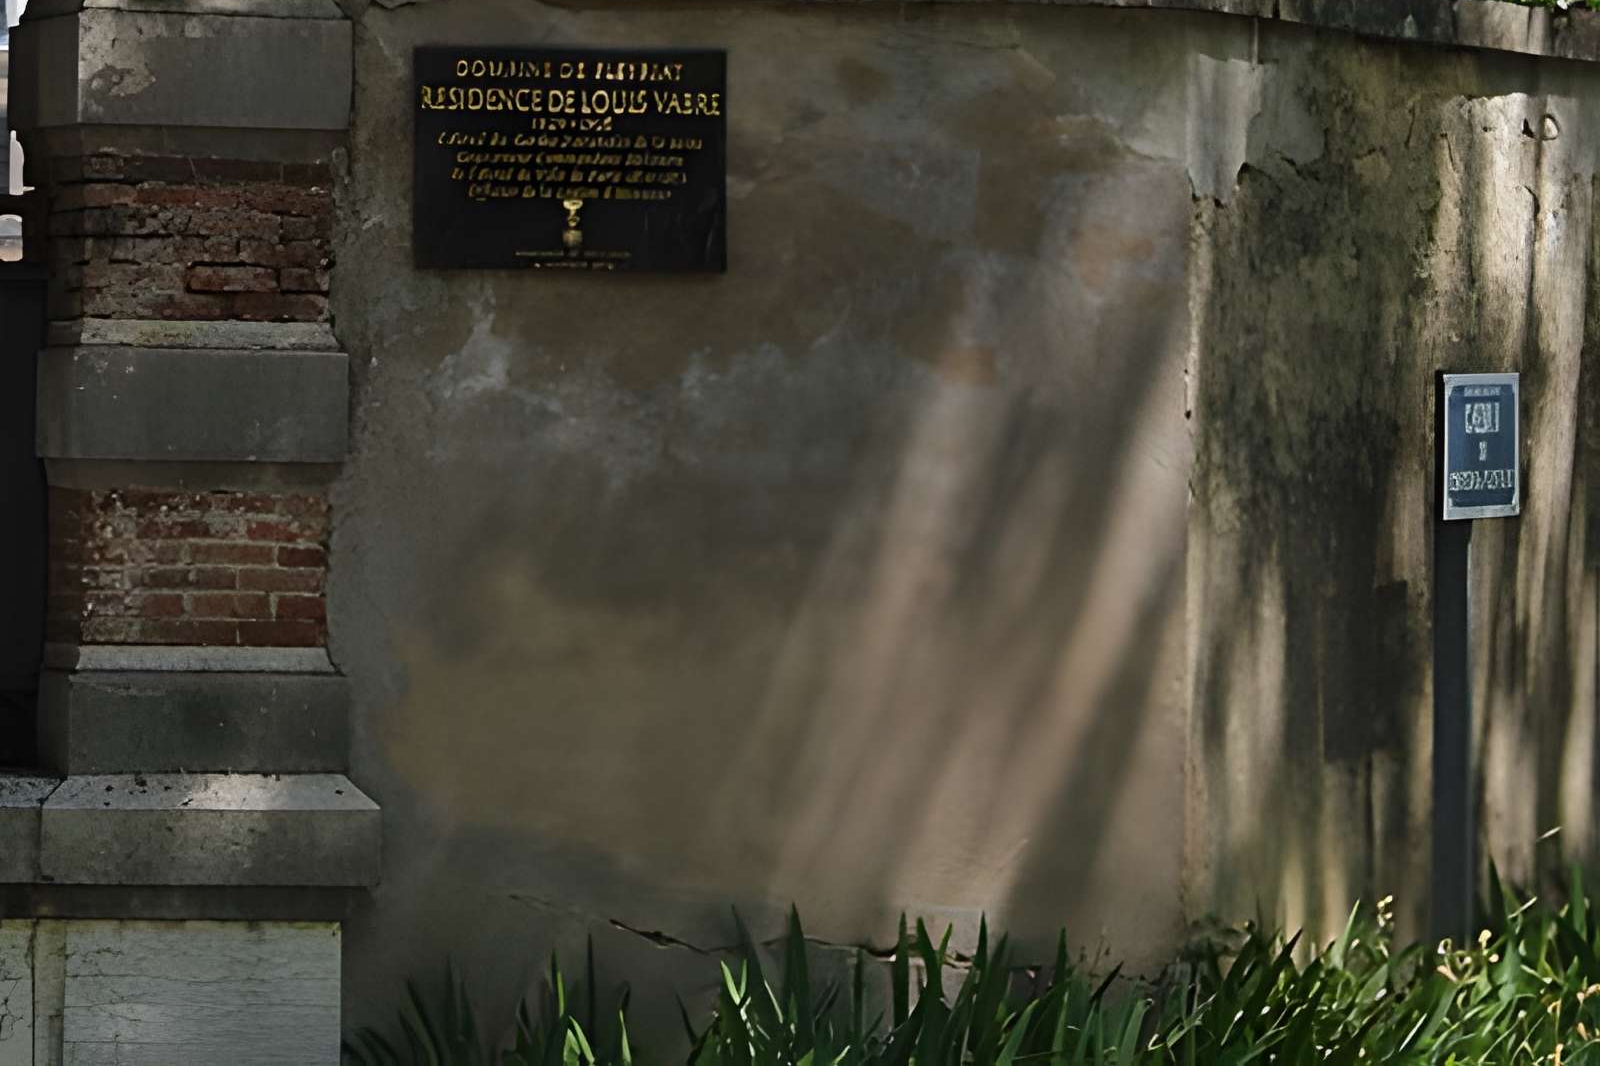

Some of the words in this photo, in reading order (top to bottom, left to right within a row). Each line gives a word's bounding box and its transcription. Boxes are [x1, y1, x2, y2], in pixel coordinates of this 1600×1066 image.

[420, 85, 543, 112] RESIDENCE
[548, 88, 576, 114] DE
[581, 89, 648, 115] LOUIS
